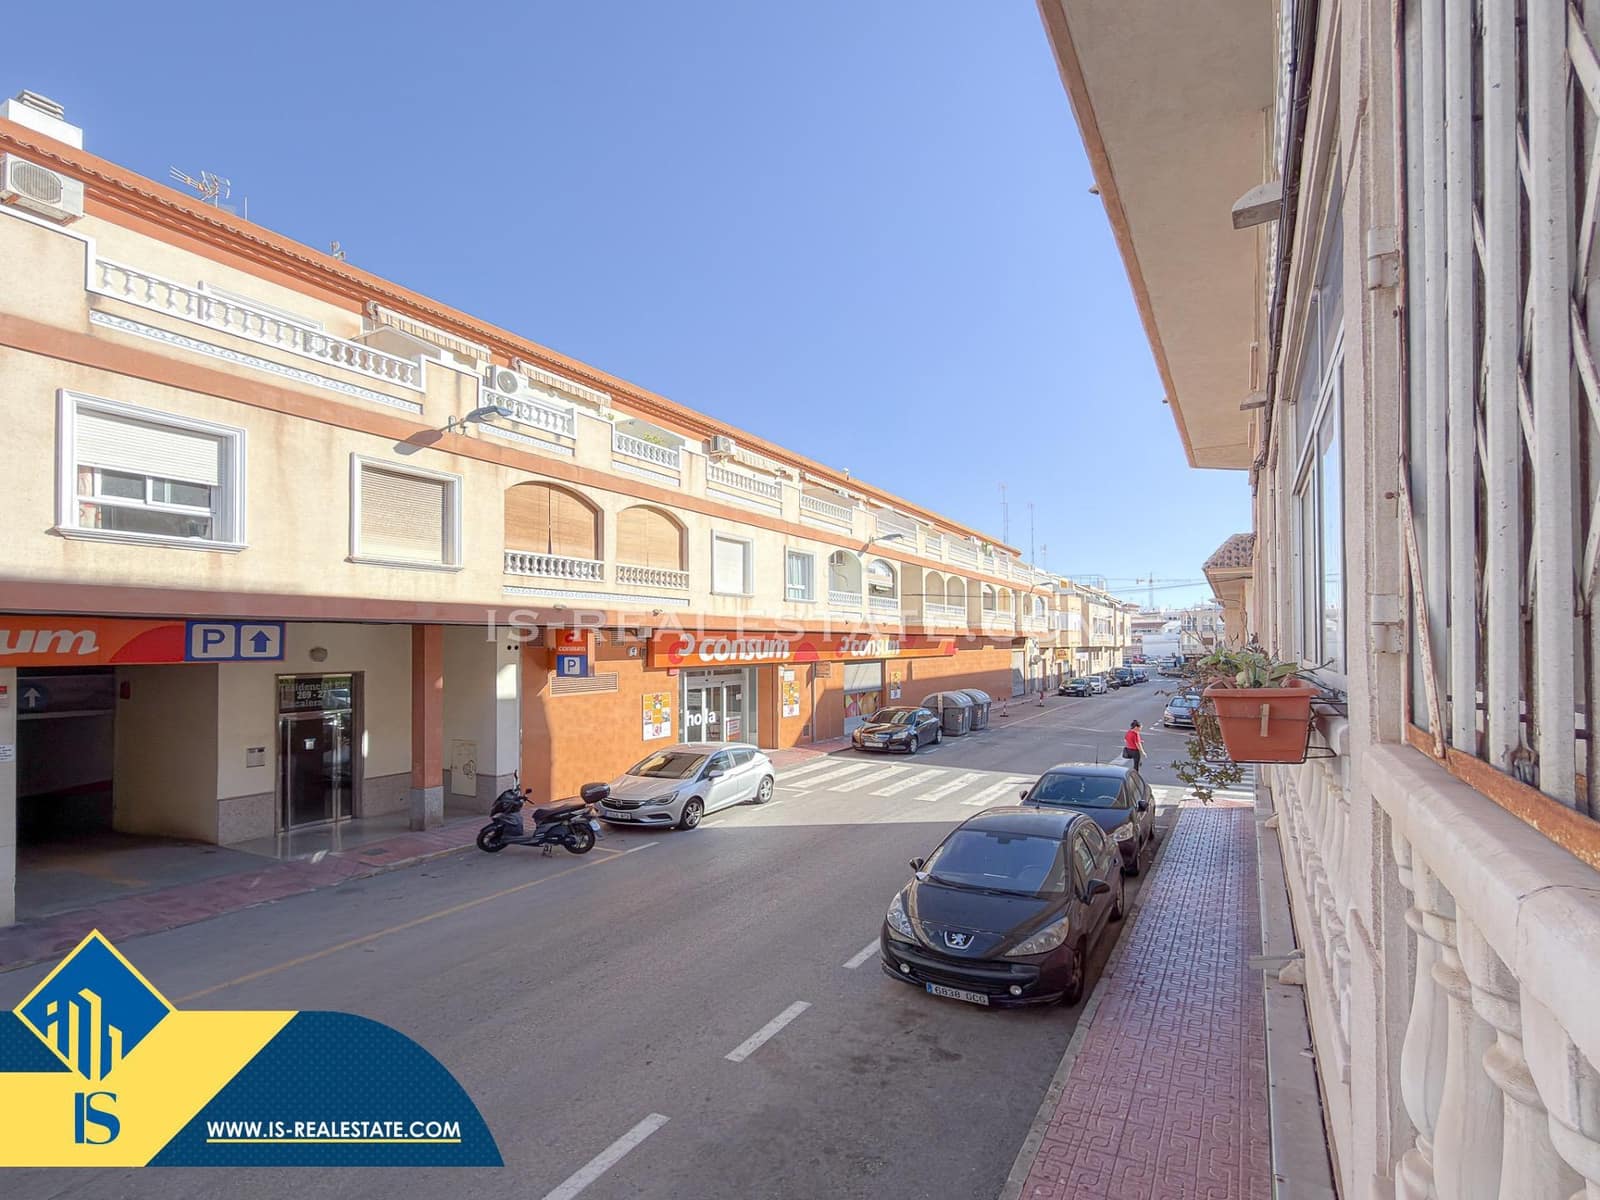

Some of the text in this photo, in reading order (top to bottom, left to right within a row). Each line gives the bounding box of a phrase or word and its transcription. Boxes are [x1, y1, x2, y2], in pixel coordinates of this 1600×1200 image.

[0, 629, 99, 656] um
[202, 628, 226, 654] P
[698, 636, 791, 662] consum
[851, 637, 900, 657] consum
[567, 660, 577, 672] P
[686, 708, 716, 727] hola
[935, 986, 961, 999] 6838
